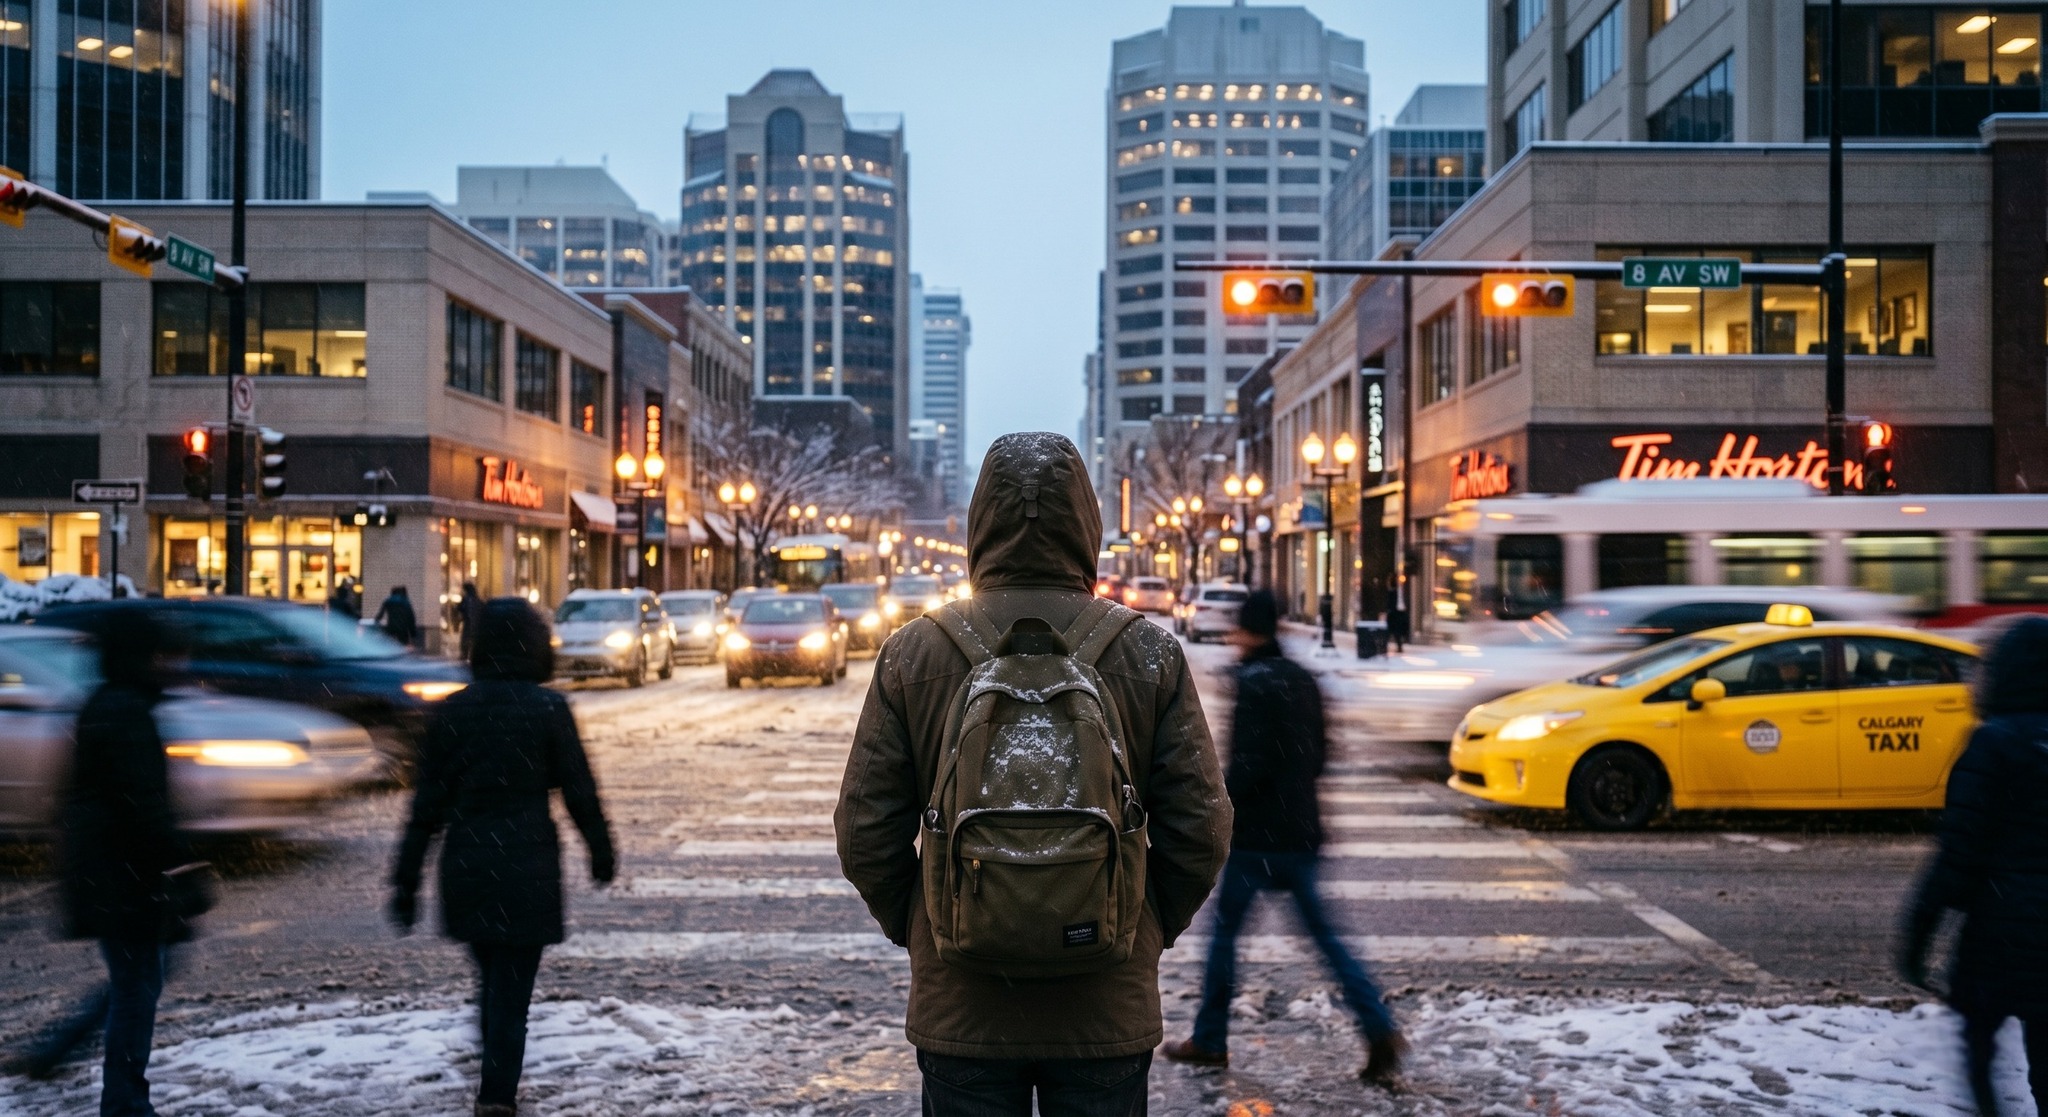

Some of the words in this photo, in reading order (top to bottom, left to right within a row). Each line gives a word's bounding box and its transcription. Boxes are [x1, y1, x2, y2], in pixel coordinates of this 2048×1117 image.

[170, 242, 178, 263] 8
[181, 247, 195, 268] AV
[198, 253, 211, 275] SW
[1632, 263, 1646, 283] 8
[1658, 264, 1687, 283] AV
[1699, 264, 1730, 284] SW
[1611, 433, 1700, 482] Tim
[1709, 433, 1896, 490] Horton
[1858, 716, 1925, 730] CALGARY
[1865, 732, 1920, 751] TAXI
